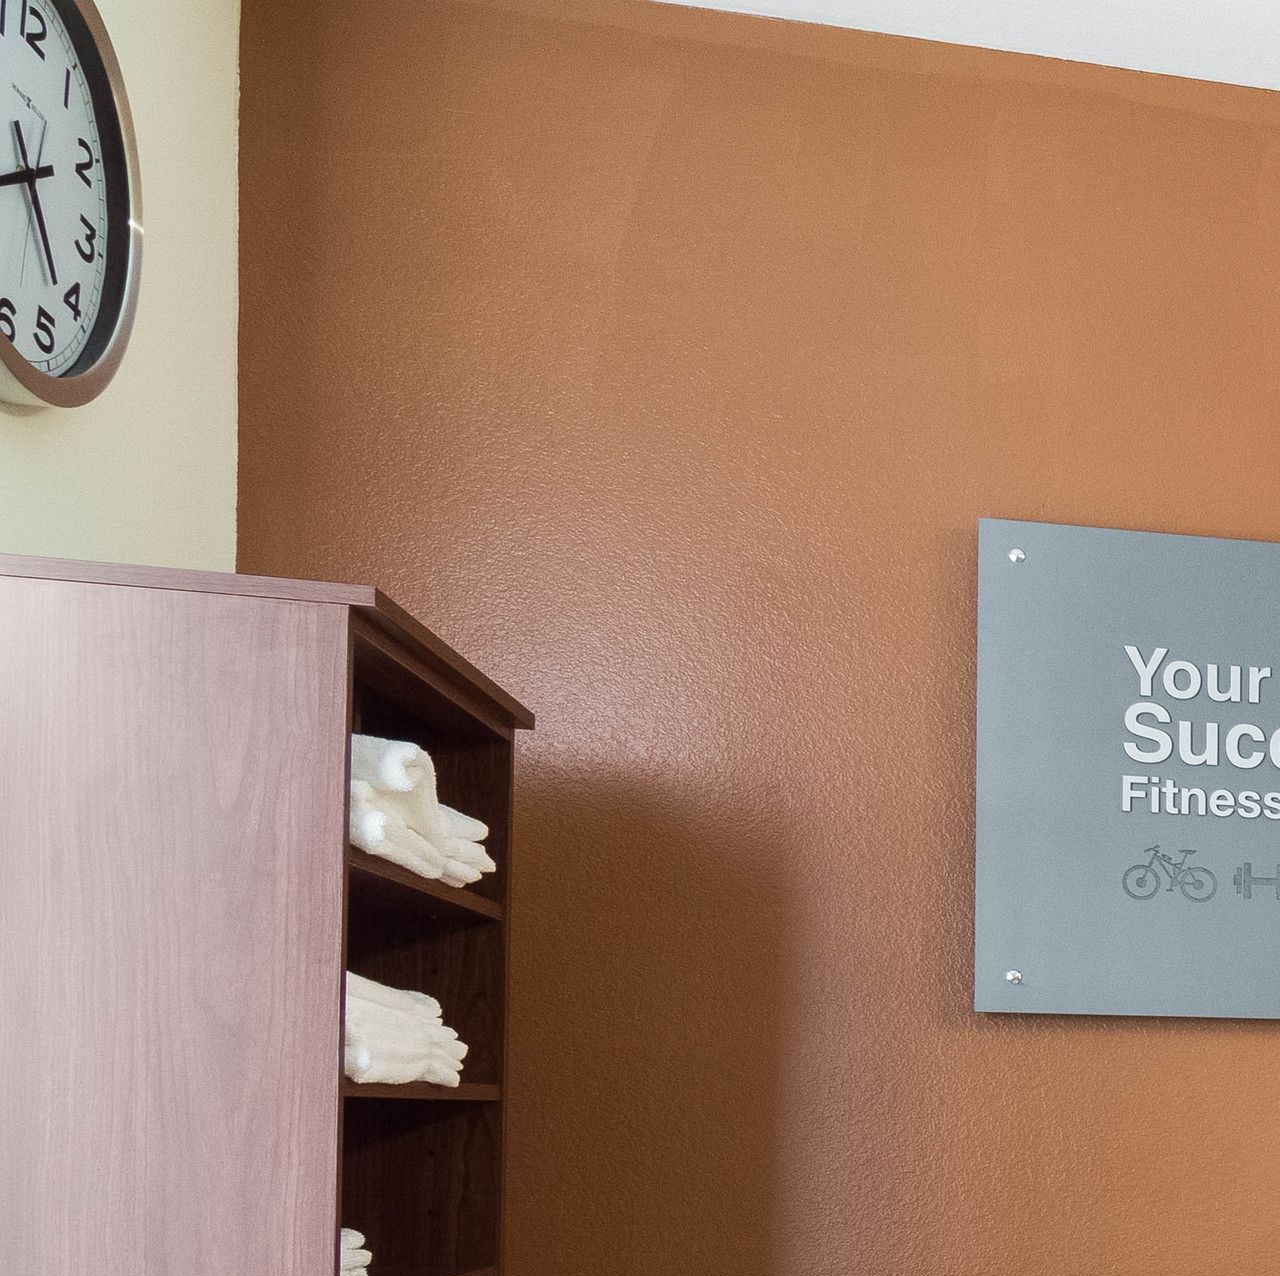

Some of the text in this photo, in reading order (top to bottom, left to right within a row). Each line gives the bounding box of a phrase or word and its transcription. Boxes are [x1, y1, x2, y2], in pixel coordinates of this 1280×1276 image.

[75, 137, 96, 189] 2
[74, 214, 97, 263] 3
[63, 281, 81, 322] 4
[33, 304, 56, 355] 5
[1123, 645, 1272, 704] Your
